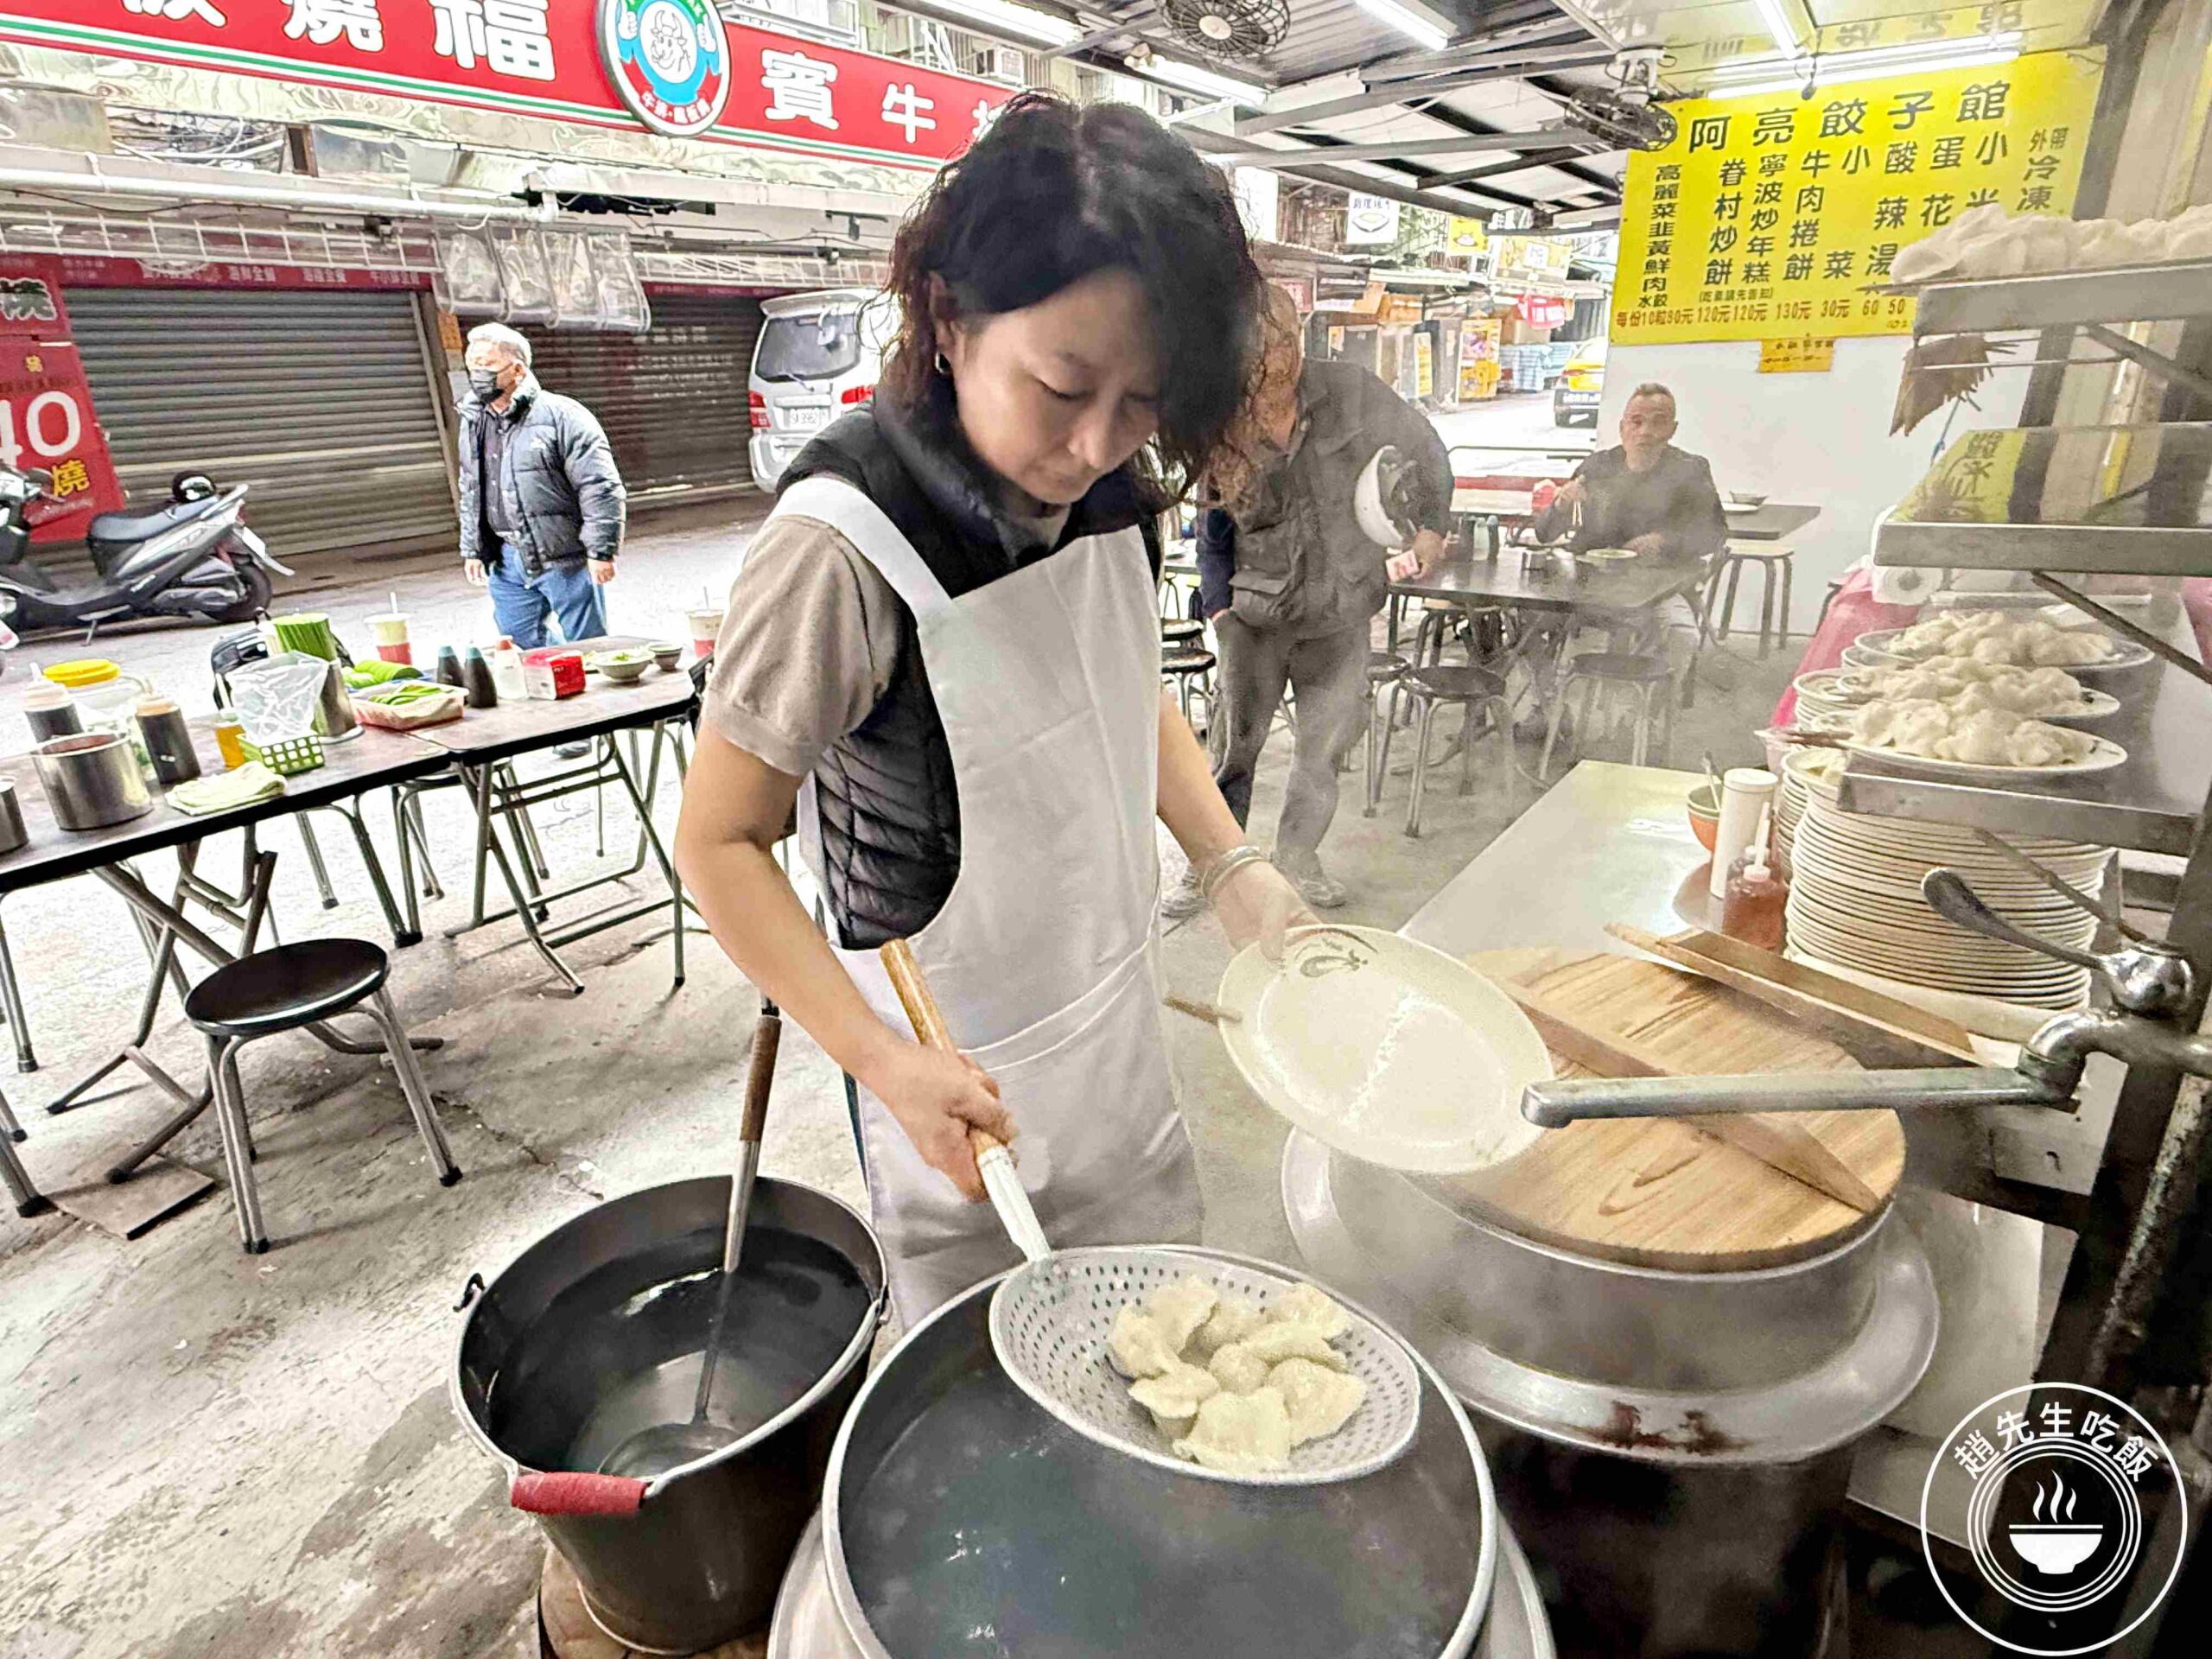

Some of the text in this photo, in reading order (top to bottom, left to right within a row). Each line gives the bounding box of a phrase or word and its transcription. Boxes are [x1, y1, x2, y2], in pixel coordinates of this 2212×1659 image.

[120, 0, 556, 83] 燒福
[1688, 79, 2012, 153] 阿亮餃子館
[1704, 157, 1747, 286] 眷村炒餅
[1741, 153, 1789, 284] 寧波炒年糕
[1783, 149, 1831, 281] 牛肉捲餅
[1920, 136, 1966, 227] 蛋花
[1697, 305, 1730, 324] 120元
[1732, 302, 1769, 322] 120元
[1776, 300, 1813, 321] 130元
[1820, 299, 1851, 319] 30元
